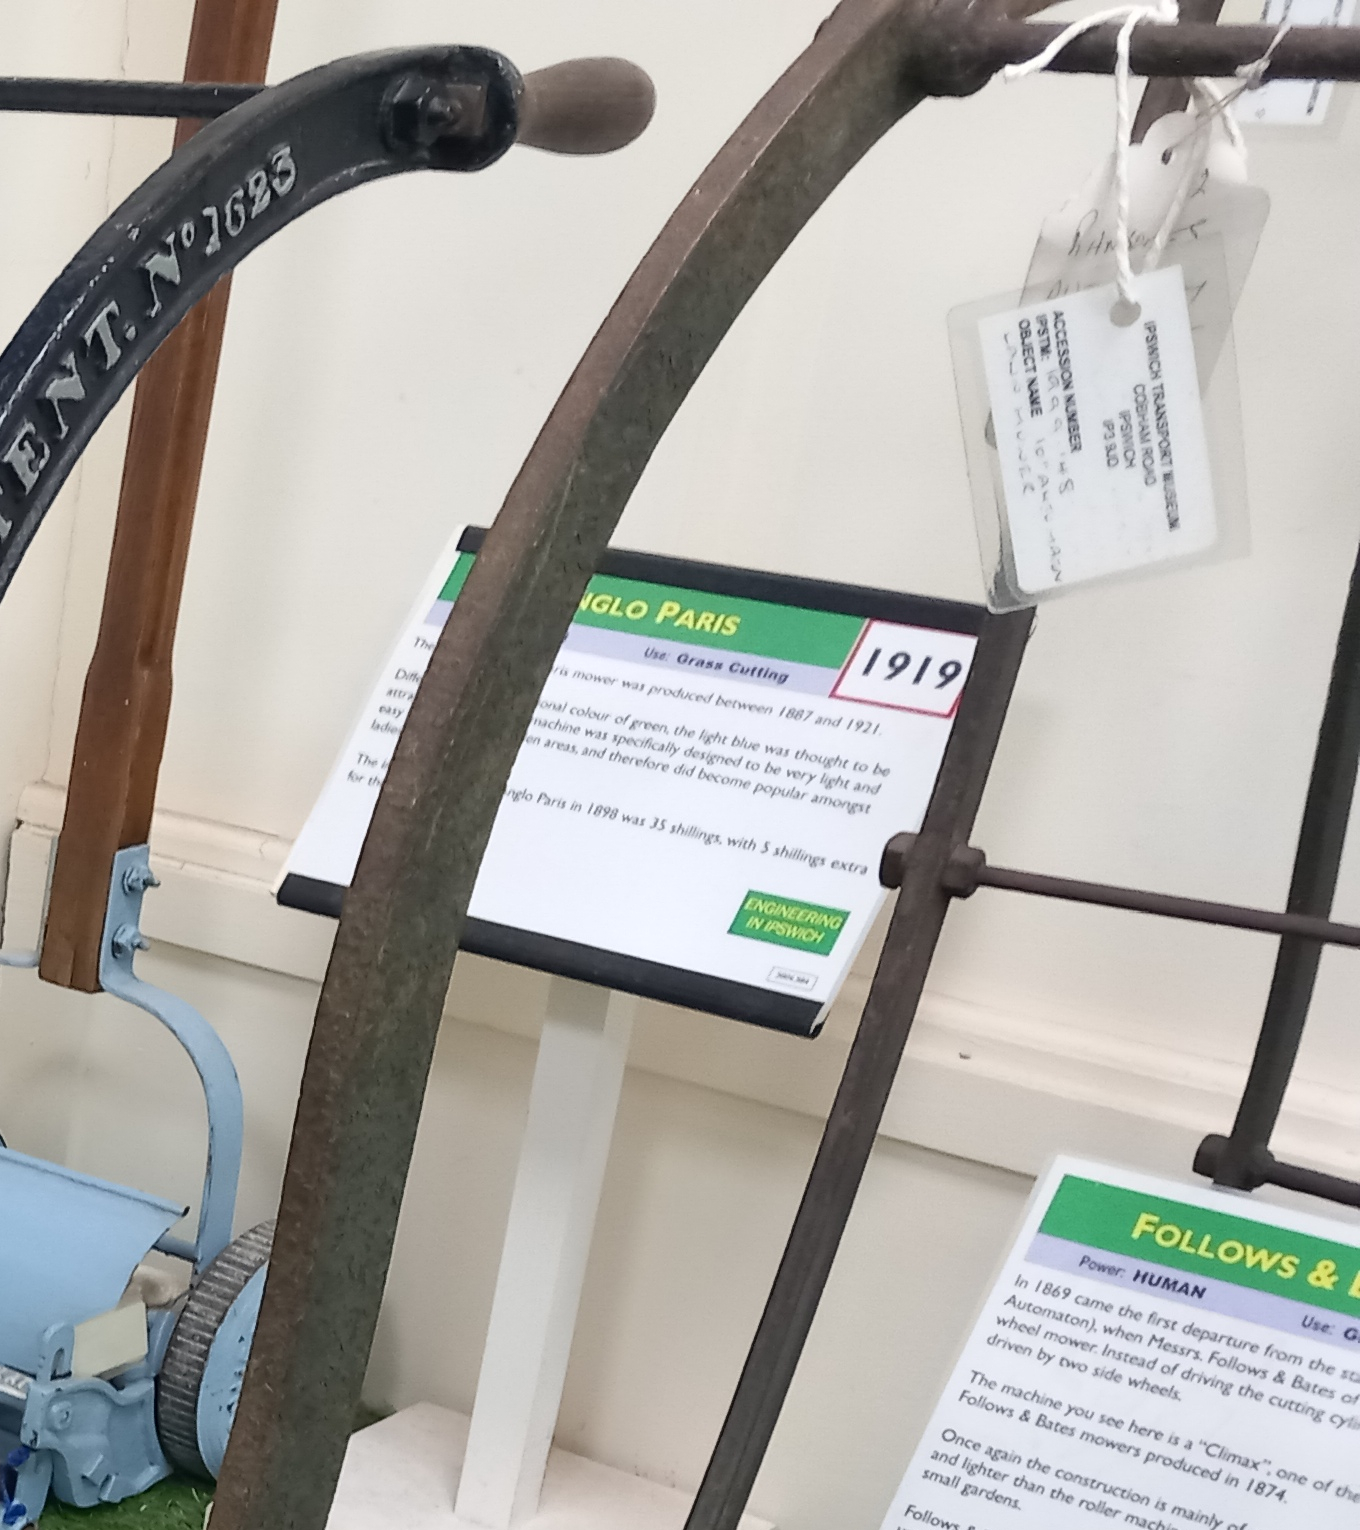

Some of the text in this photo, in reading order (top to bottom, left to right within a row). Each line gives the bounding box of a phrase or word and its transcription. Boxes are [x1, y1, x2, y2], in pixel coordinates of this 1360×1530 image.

[1019, 318, 1042, 418] OBJECT NAME
[1053, 310, 1074, 392] ACCESSION
[1144, 320, 1162, 380] IPSWICH
[1063, 393, 1082, 453] NUMBER
[1119, 410, 1136, 469] IPSWICH
[1152, 383, 1173, 466] TRANSPORT
[1142, 446, 1157, 487] ROAD
[580, 592, 741, 636] NGLO PARIS
[571, 670, 616, 686] mower
[621, 679, 645, 692] was
[645, 684, 715, 704] produced
[714, 693, 773, 715] between
[778, 705, 814, 722] 1887
[813, 715, 843, 728] and
[677, 653, 723, 670] Grass
[729, 661, 789, 685] Cutting
[862, 647, 962, 690] 1919
[535, 791, 567, 809] Paris
[586, 801, 619, 820] 1898
[621, 813, 646, 827] was
[668, 821, 722, 846] shillings,
[726, 836, 757, 851] with
[772, 844, 826, 868] shillings
[829, 859, 868, 875] extra
[744, 897, 843, 930] ENGINEERING
[746, 915, 825, 944] IN IPSWICH
[1131, 1212, 1339, 1290] FOLLOWS &
[1013, 1273, 1336, 1376] In 1869 came the first departure from the
[1079, 1255, 1333, 1336] Power: HUMAN Use:
[985, 1332, 1181, 1402] driven by two side wheels.
[995, 1315, 1326, 1423] wheel mower. Instead of driving the cutting
[1002, 1293, 1097, 1333] Automaton),
[1102, 1324, 1143, 1344] when
[1146, 1333, 1203, 1361] Messrs.
[1206, 1349, 1269, 1380] Follows
[1271, 1369, 1286, 1385] &
[1290, 1373, 1336, 1399] Bates
[957, 1388, 1287, 1504] Follows & Bates mowers produced in 1874.
[969, 1368, 997, 1390] The
[999, 1383, 1063, 1410] machine
[1062, 1403, 1095, 1421] you
[1097, 1413, 1125, 1430] see
[1126, 1418, 1164, 1441] here
[1166, 1433, 1180, 1446] is
[1182, 1438, 1193, 1451] a
[1274, 1467, 1308, 1486] one
[1311, 1478, 1334, 1492] of
[921, 1468, 1021, 1510] small gardens.
